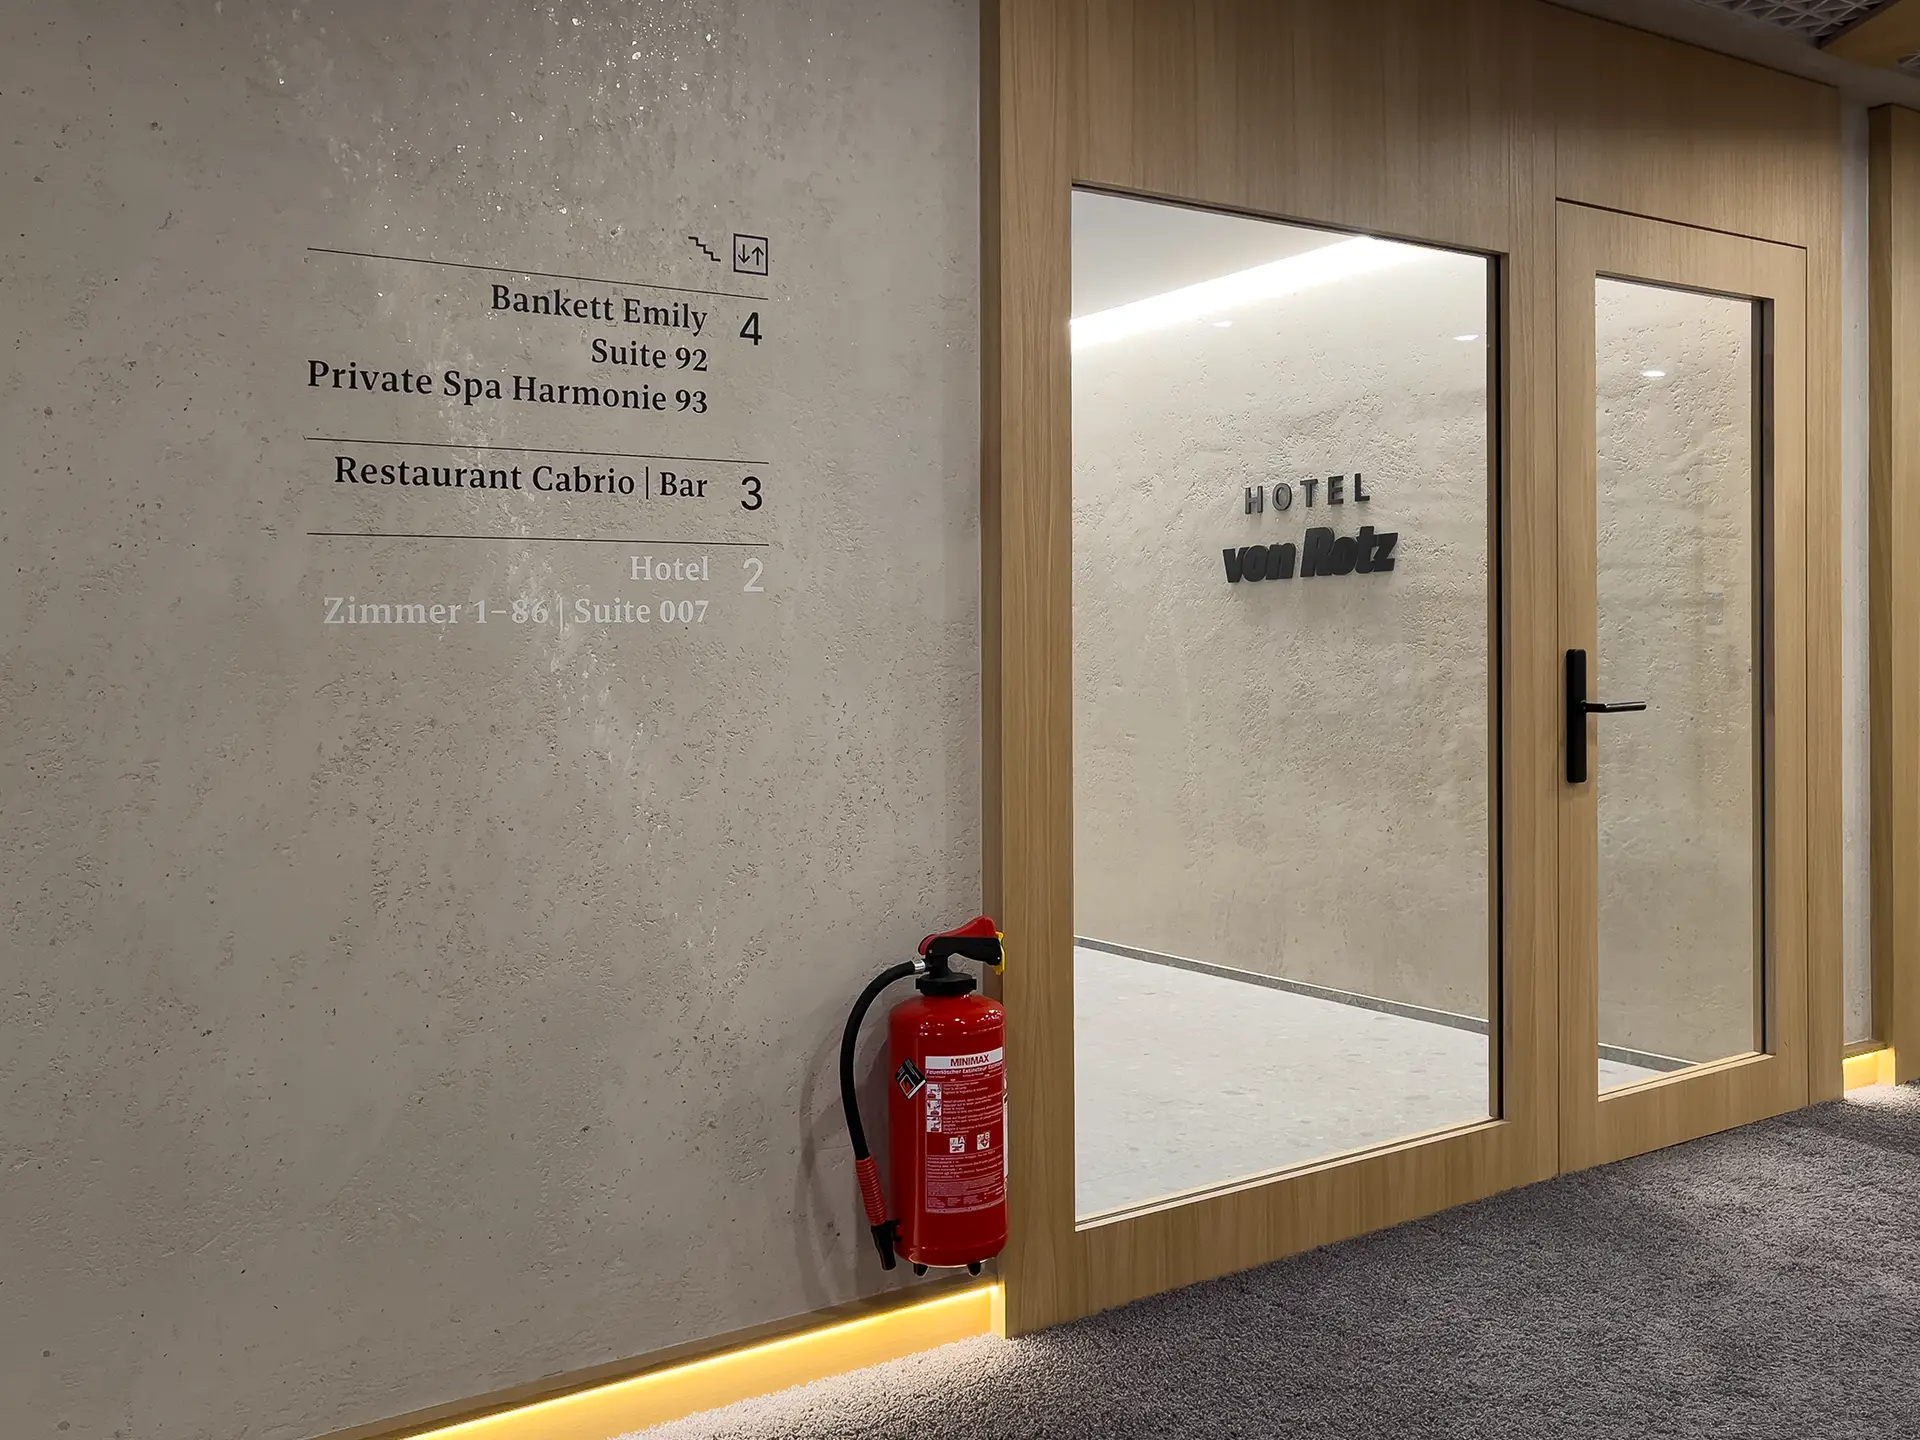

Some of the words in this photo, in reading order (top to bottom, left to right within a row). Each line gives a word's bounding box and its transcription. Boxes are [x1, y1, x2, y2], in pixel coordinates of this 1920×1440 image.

[491, 284, 614, 321] Bankett
[623, 298, 708, 337] Emily
[739, 311, 763, 345] 4
[591, 338, 667, 369] Suite
[675, 347, 708, 372] 92
[307, 360, 432, 394] Private
[443, 370, 502, 406] Spa
[512, 375, 667, 411] Harmonie
[675, 390, 708, 414] 93
[334, 456, 522, 490] Restaurant
[532, 466, 635, 494] Cabrio
[660, 472, 708, 498] Bar
[740, 476, 763, 510] 3
[1245, 473, 1370, 514] HOTEL
[630, 556, 710, 581] Hotel
[1223, 543, 1296, 583] von
[1300, 526, 1398, 577] Rotz
[743, 558, 765, 593] 2
[324, 596, 462, 624] Zimmer
[574, 597, 651, 624] Suite
[659, 600, 709, 624] 007
[950, 1054, 990, 1067] MINIMAX
